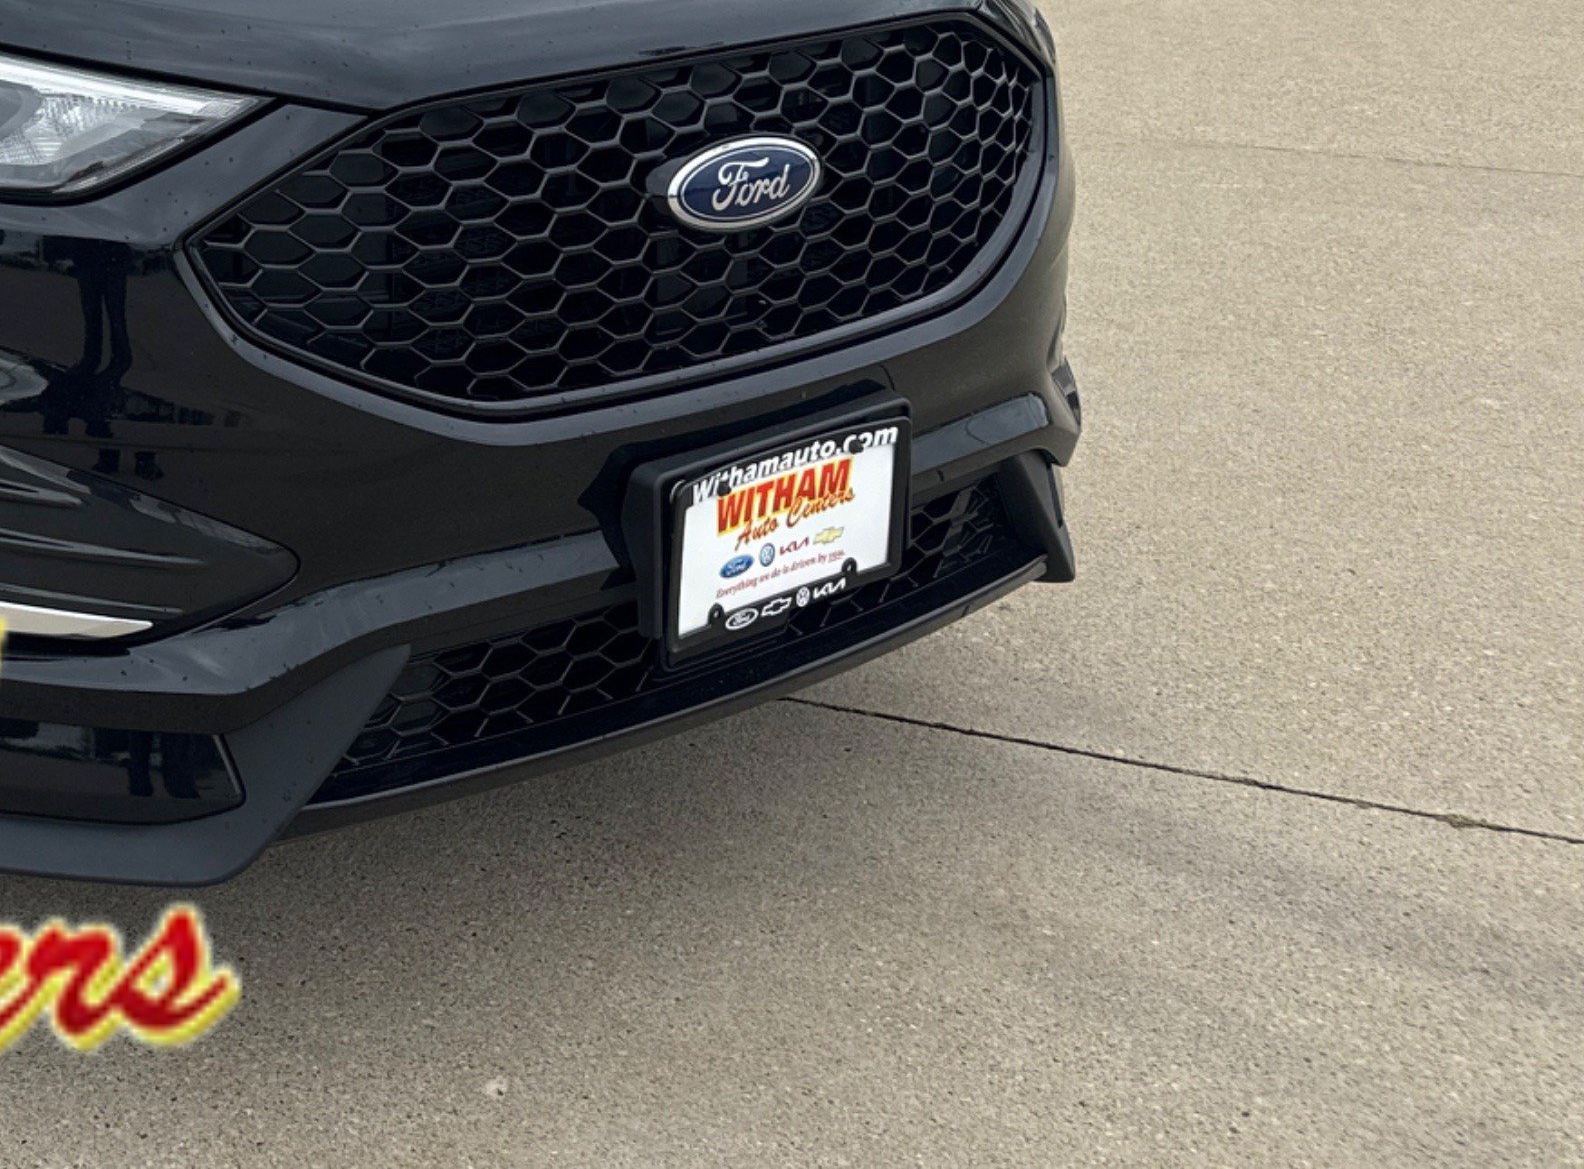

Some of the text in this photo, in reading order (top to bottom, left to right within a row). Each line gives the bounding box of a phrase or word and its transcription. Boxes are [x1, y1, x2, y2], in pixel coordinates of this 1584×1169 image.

[711, 156, 791, 212] Ford
[716, 457, 853, 535] WITHAM
[735, 485, 857, 552] Auto Centers
